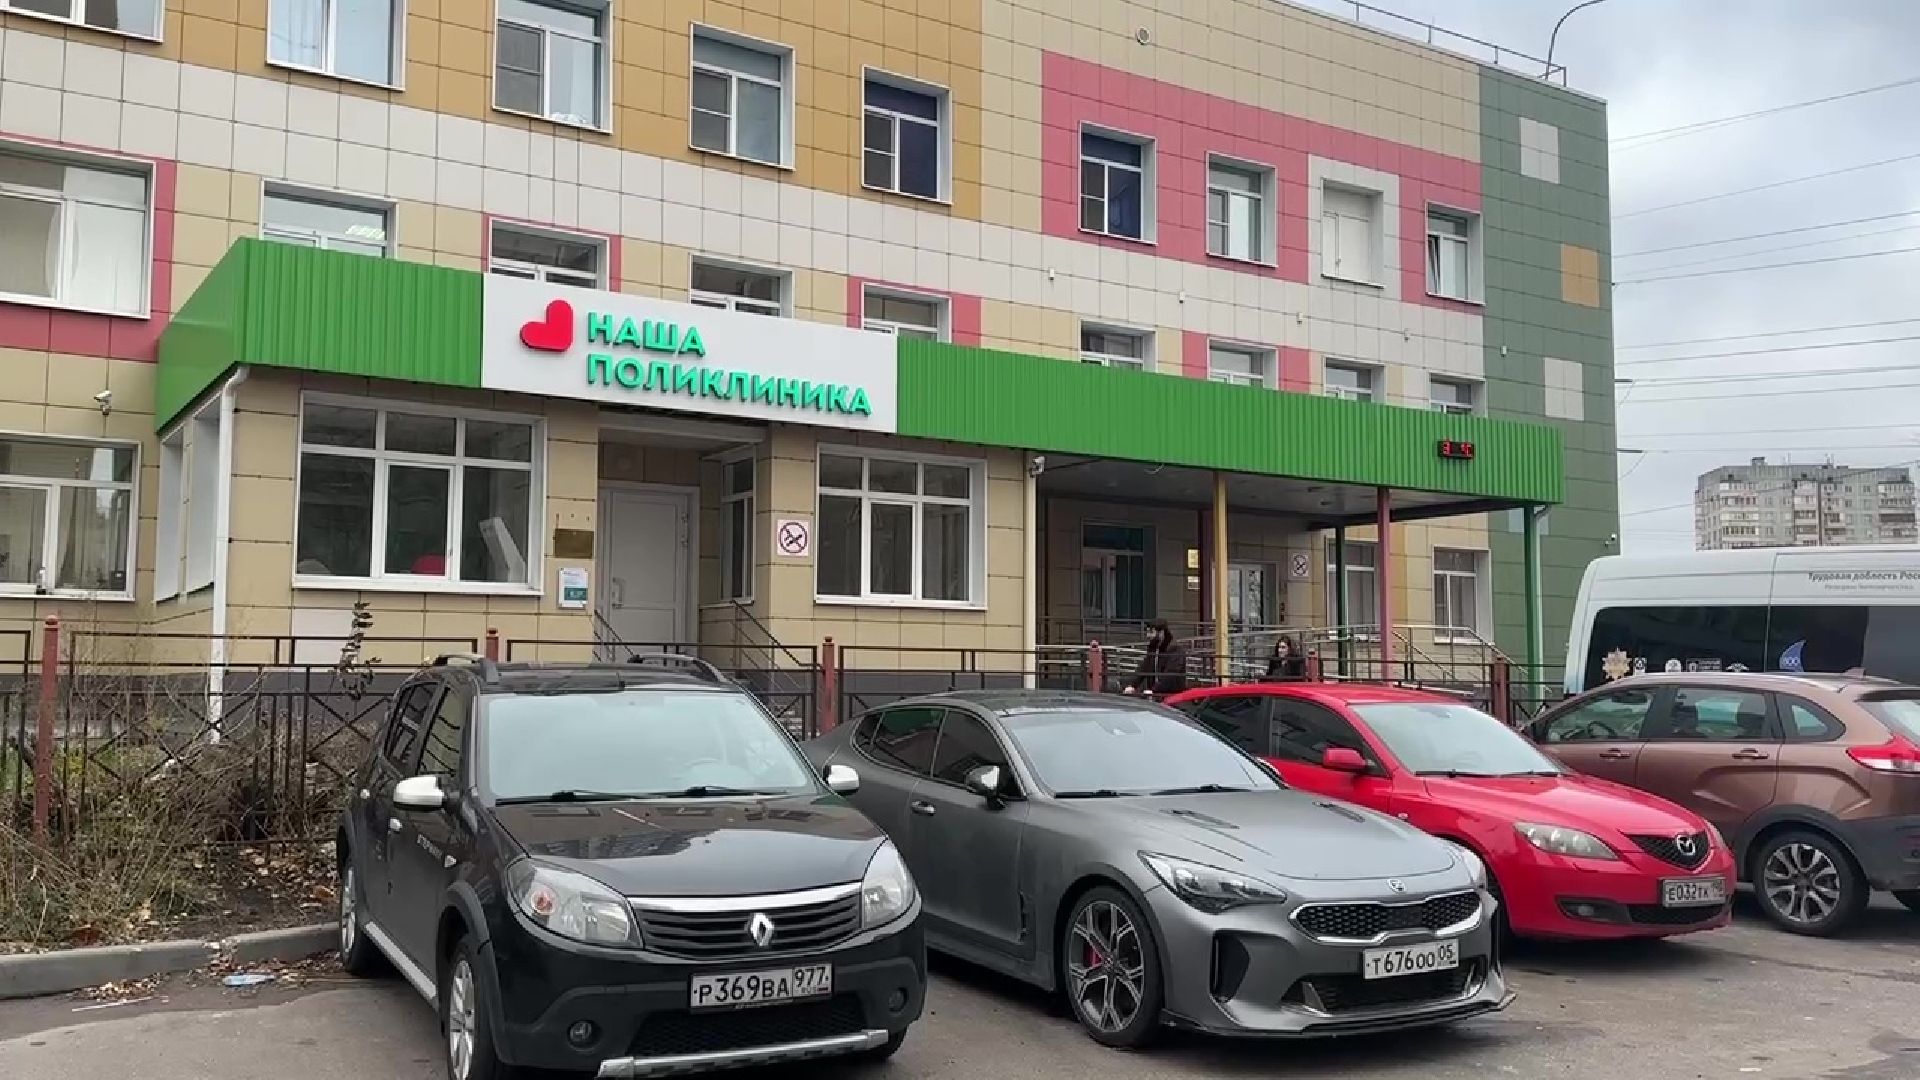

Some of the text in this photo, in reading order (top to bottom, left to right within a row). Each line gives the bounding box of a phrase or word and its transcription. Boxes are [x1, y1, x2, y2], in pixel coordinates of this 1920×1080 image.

[587, 311, 706, 356] НАША
[586, 353, 873, 416] ПОЛИКЛИНИКА
[1808, 571, 1851, 582] Трудовая
[1852, 570, 1898, 582] доблесть
[1372, 949, 1435, 975] Т676ОО
[699, 966, 827, 1004] Р369ВА 977
